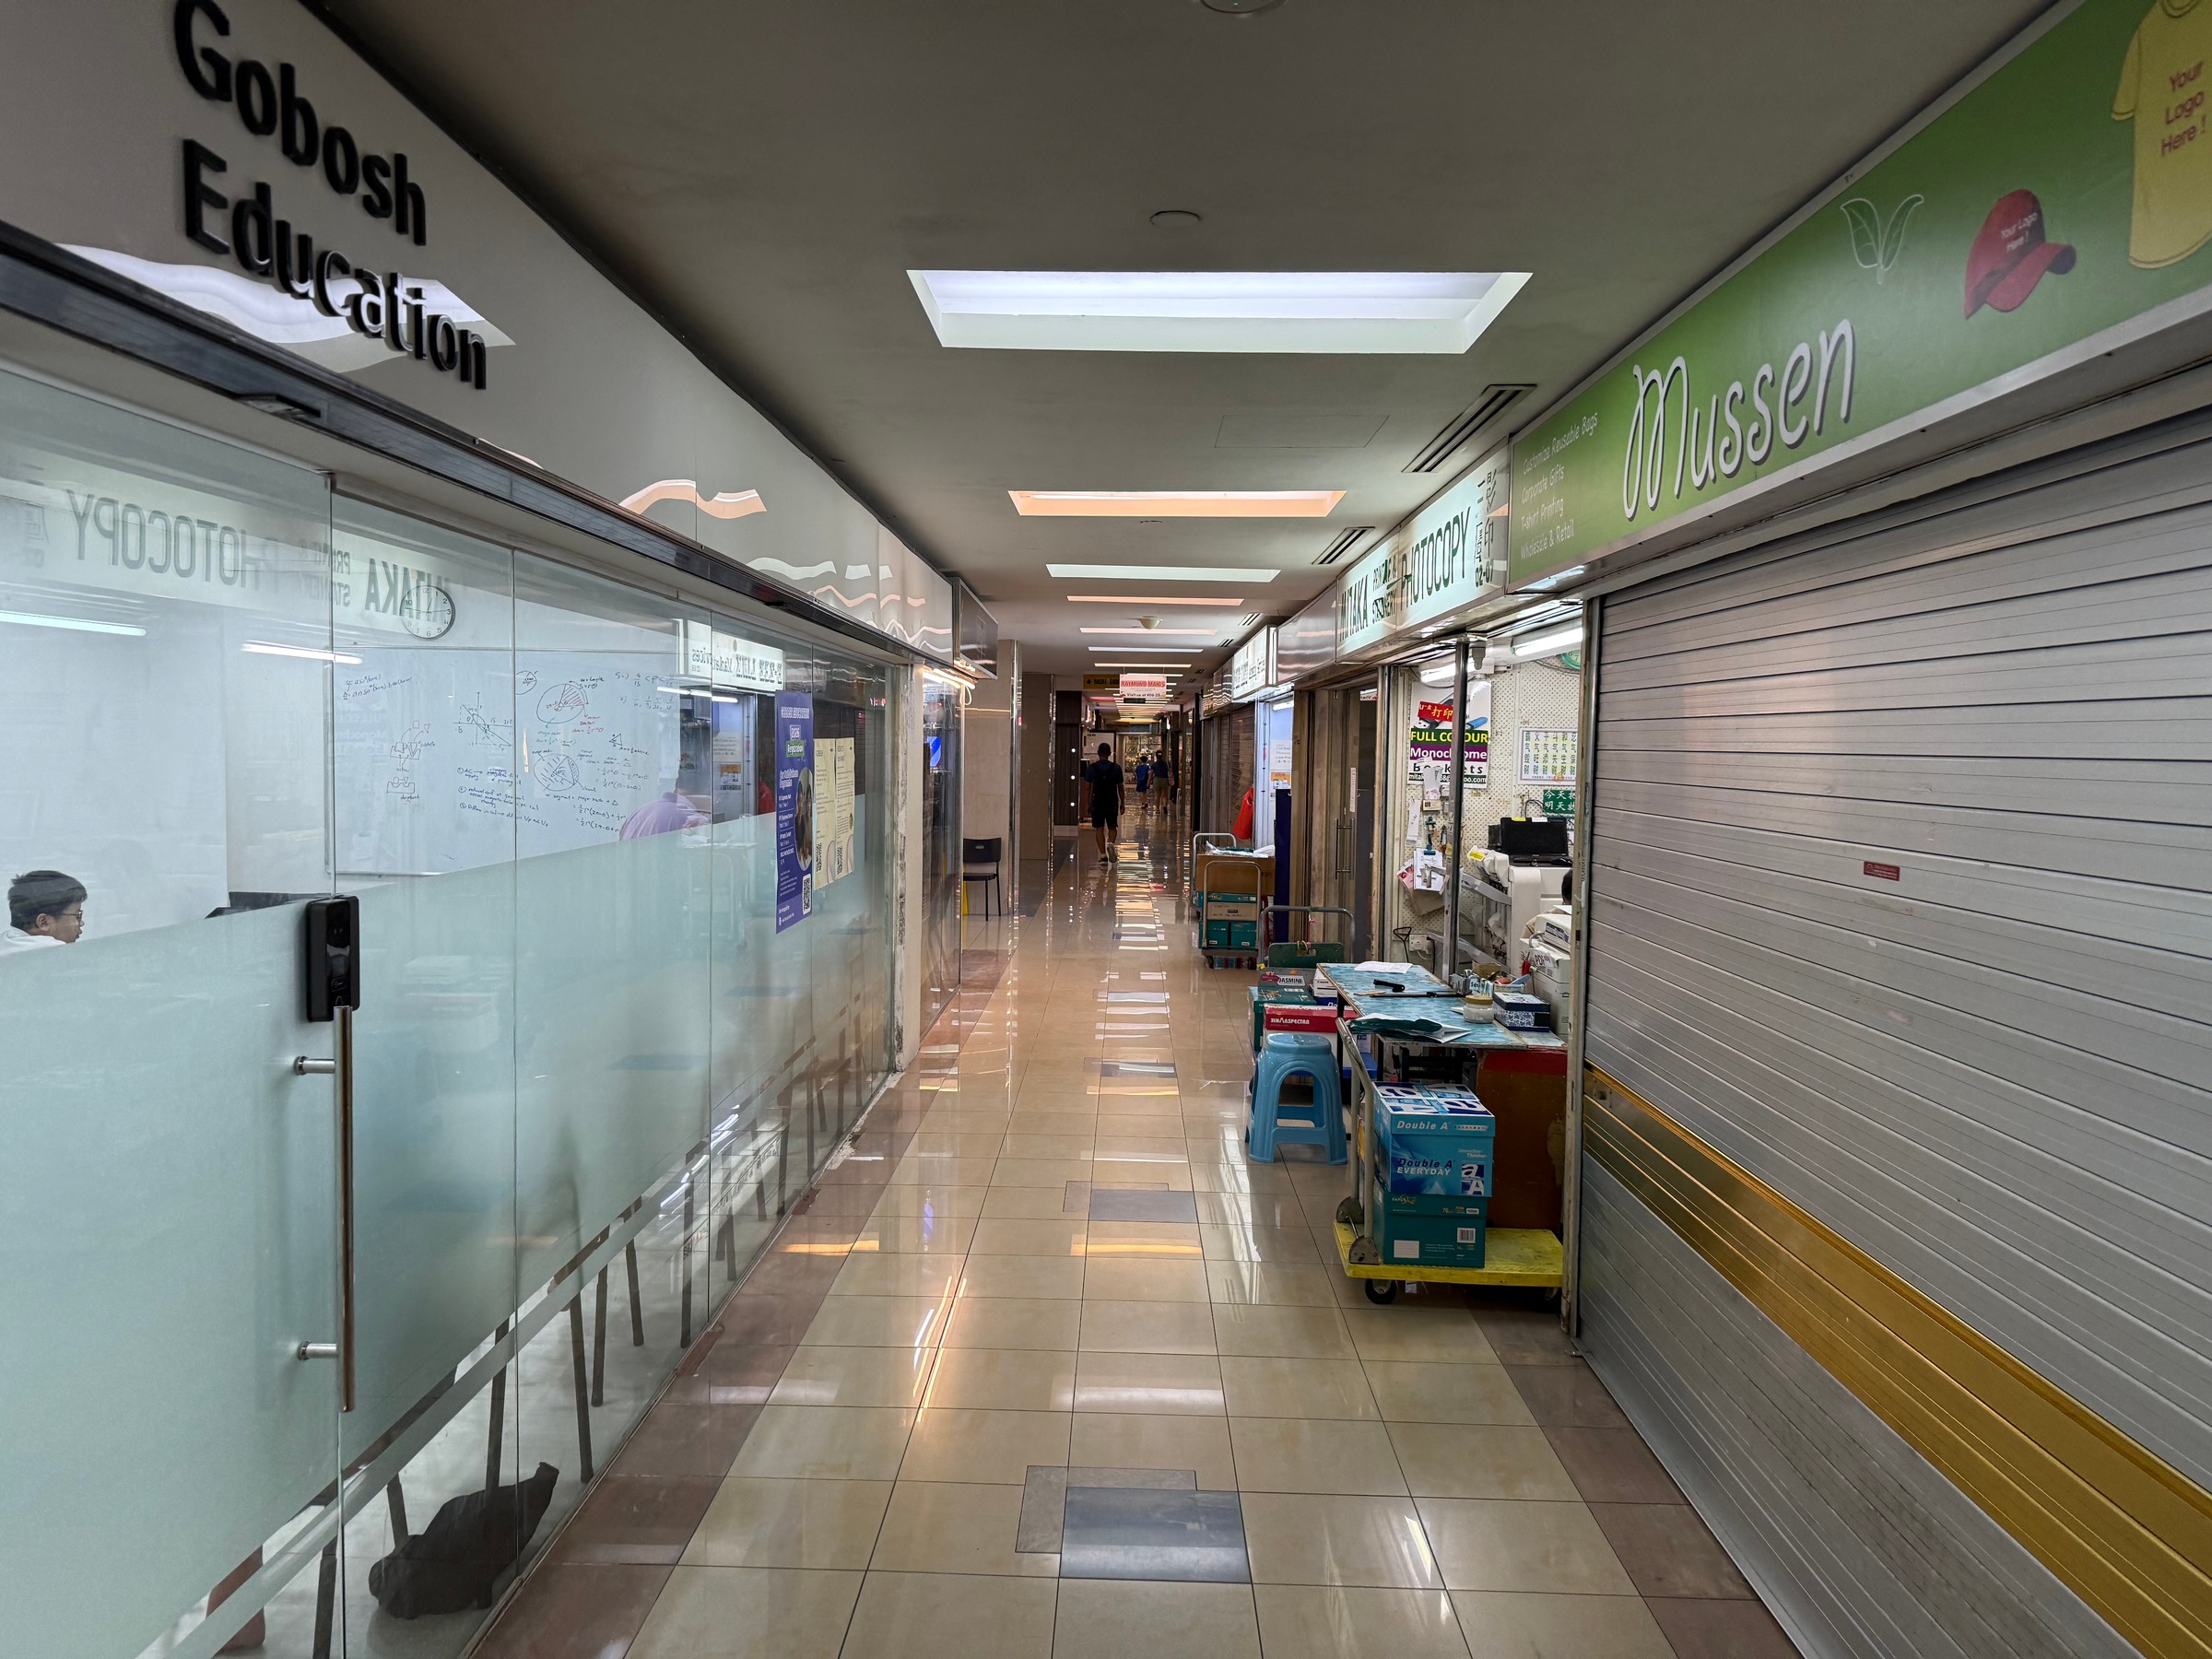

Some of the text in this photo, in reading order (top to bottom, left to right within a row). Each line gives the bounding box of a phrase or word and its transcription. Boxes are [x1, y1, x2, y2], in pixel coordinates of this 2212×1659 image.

[2170, 61, 2204, 92] Your
[174, 0, 428, 246] Gobosh
[2166, 92, 2205, 125] Logo
[2161, 125, 2198, 157] Here
[183, 138, 487, 390] Education
[1623, 318, 1856, 523] Mussen
[1523, 412, 1598, 475] Customize Reusable Bags
[1522, 465, 1565, 504] Corporate Gifts
[1540, 497, 1564, 522] Printing
[1521, 533, 1547, 559] Wholesale
[1556, 519, 1574, 542] Retail
[1340, 574, 1369, 642] MITAKA
[1401, 506, 1471, 612] PHOTOCOPY
[1476, 559, 1494, 588] 02-07
[1410, 731, 1488, 743] FULL COOUR
[1396, 1121, 1449, 1130] Double A
[1397, 1167, 1451, 1176] EVERYDAY
[1399, 1159, 1453, 1169] Double A
